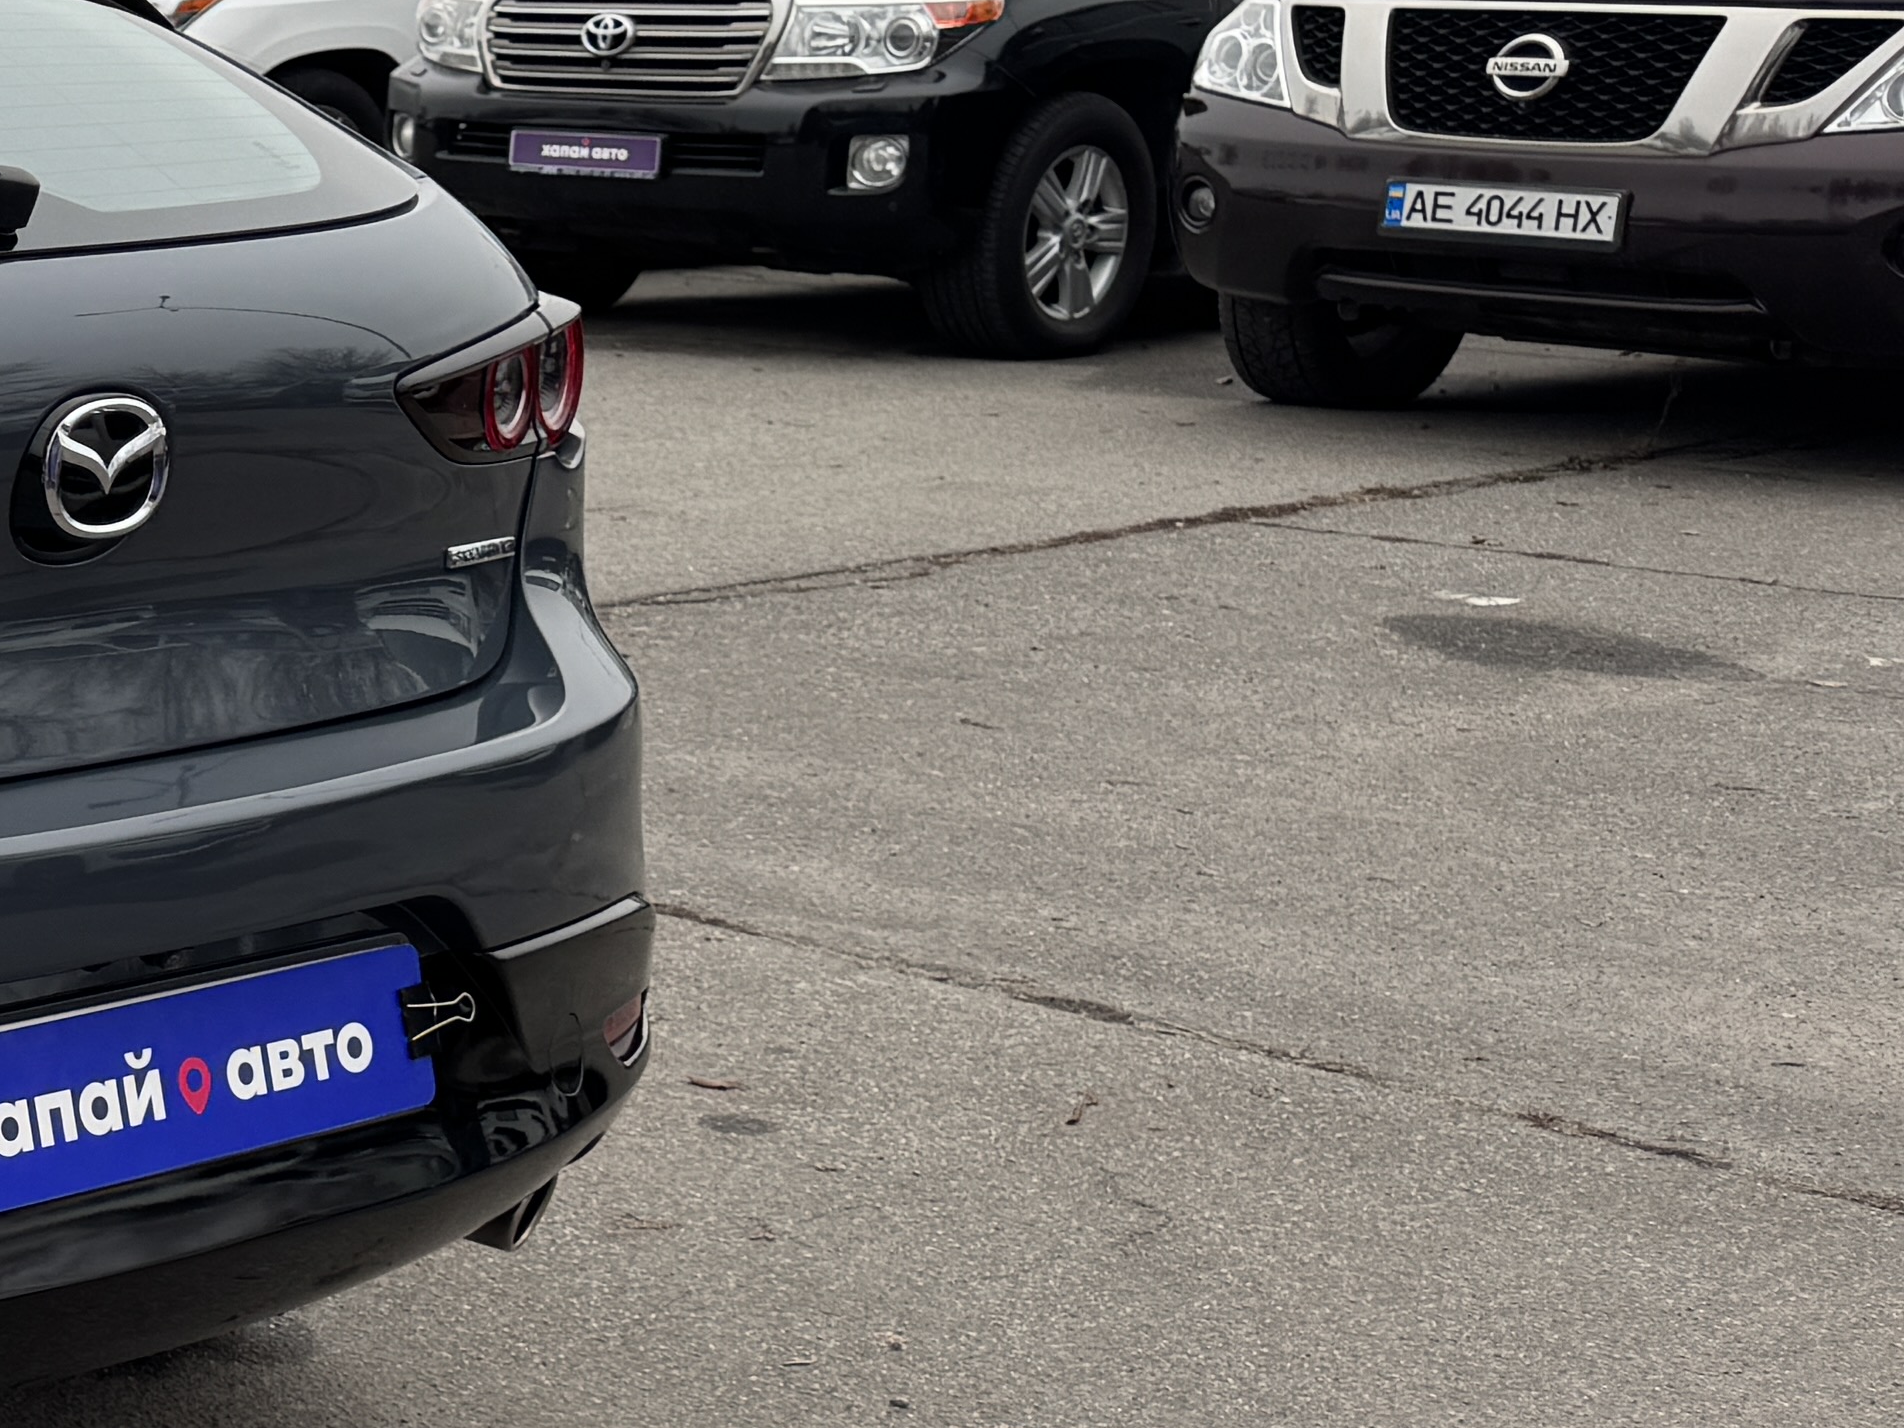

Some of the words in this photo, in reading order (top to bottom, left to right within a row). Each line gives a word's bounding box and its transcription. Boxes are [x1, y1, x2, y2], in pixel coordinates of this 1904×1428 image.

[1492, 61, 1556, 73] NISSAN
[1405, 190, 1456, 224] AE
[1465, 193, 1545, 230] 4044
[1554, 199, 1608, 235] HX
[226, 1022, 373, 1100] авто
